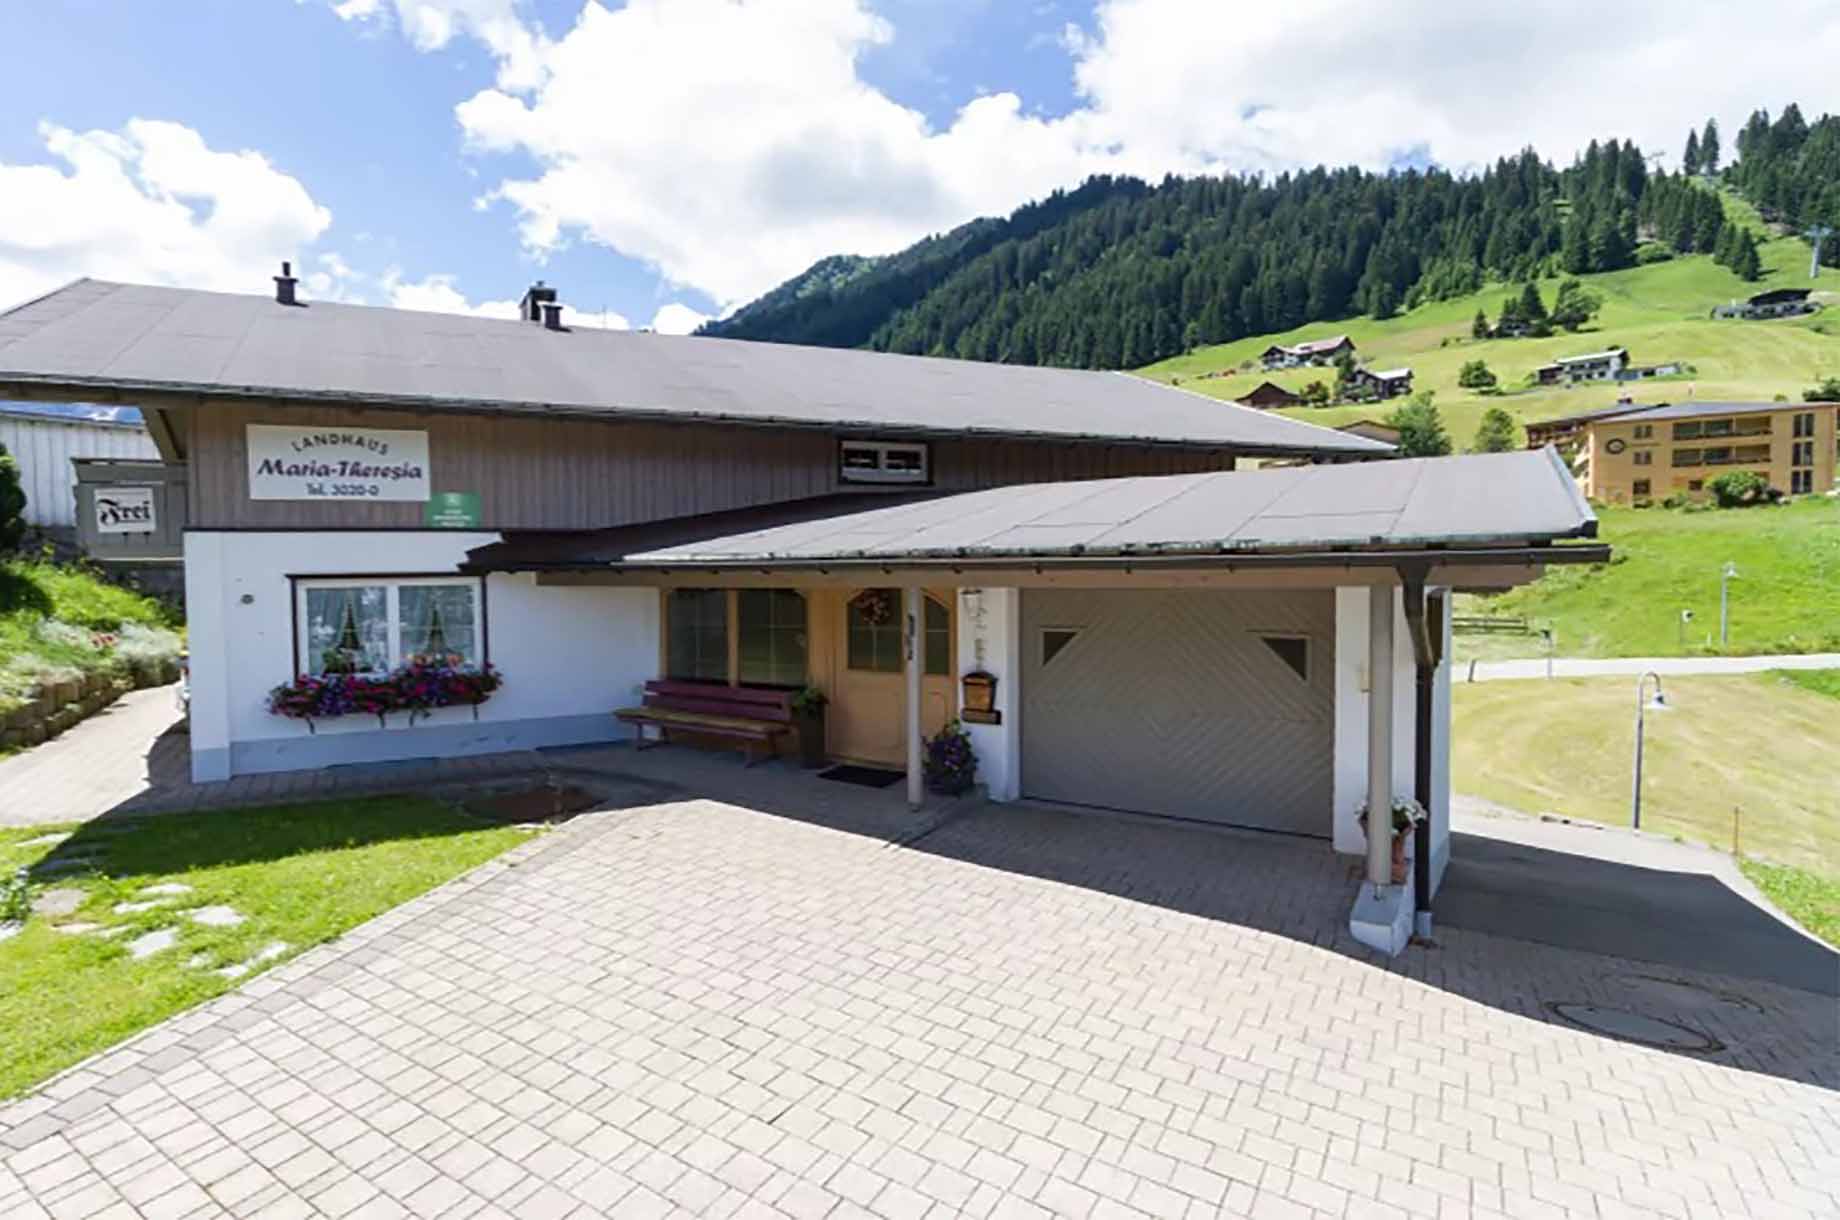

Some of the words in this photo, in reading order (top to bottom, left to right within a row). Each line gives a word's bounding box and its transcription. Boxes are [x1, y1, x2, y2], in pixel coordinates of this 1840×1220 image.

[291, 433, 389, 455] LANDHAUS
[257, 458, 422, 480] Maria-Theresia
[98, 498, 150, 526] Frei
